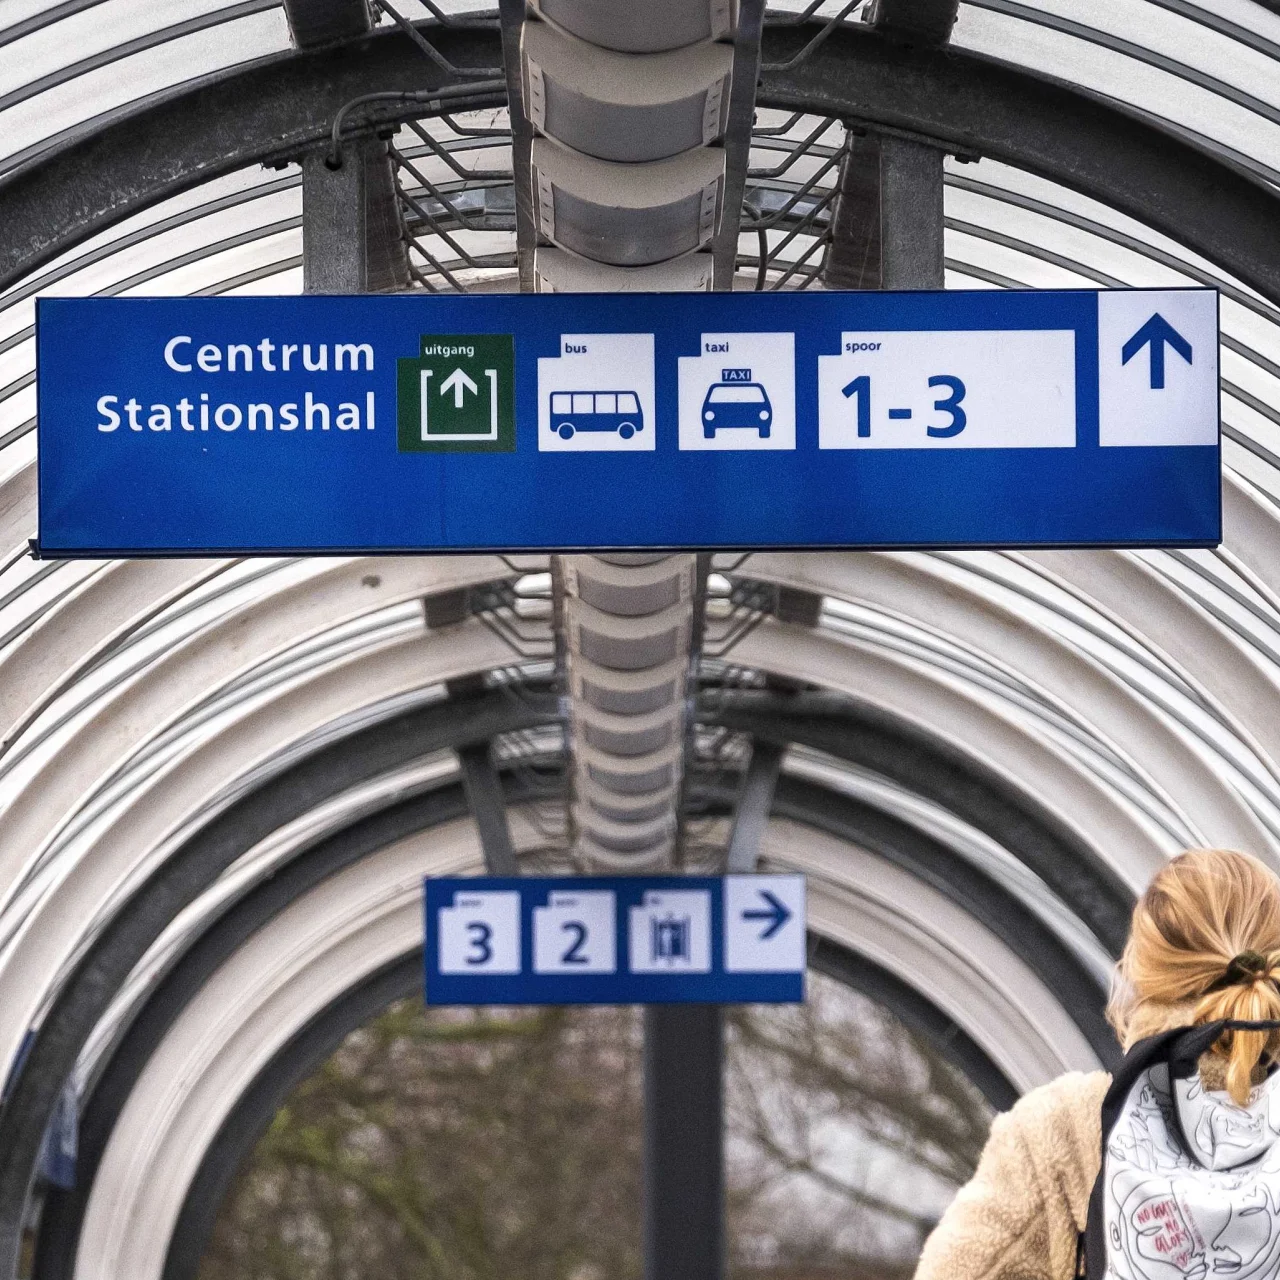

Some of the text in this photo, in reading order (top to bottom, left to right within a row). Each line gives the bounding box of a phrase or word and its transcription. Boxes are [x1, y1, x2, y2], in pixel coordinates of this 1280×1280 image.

[164, 335, 375, 373] Centrum
[424, 344, 475, 358] uitgang
[565, 342, 588, 354] bus
[705, 342, 730, 353] taxi
[845, 342, 882, 354] spoor
[723, 370, 751, 380] TAXI
[96, 391, 376, 432] Stationshal
[841, 374, 968, 439] 1-3
[464, 921, 493, 965] 3
[561, 921, 590, 964] 2
